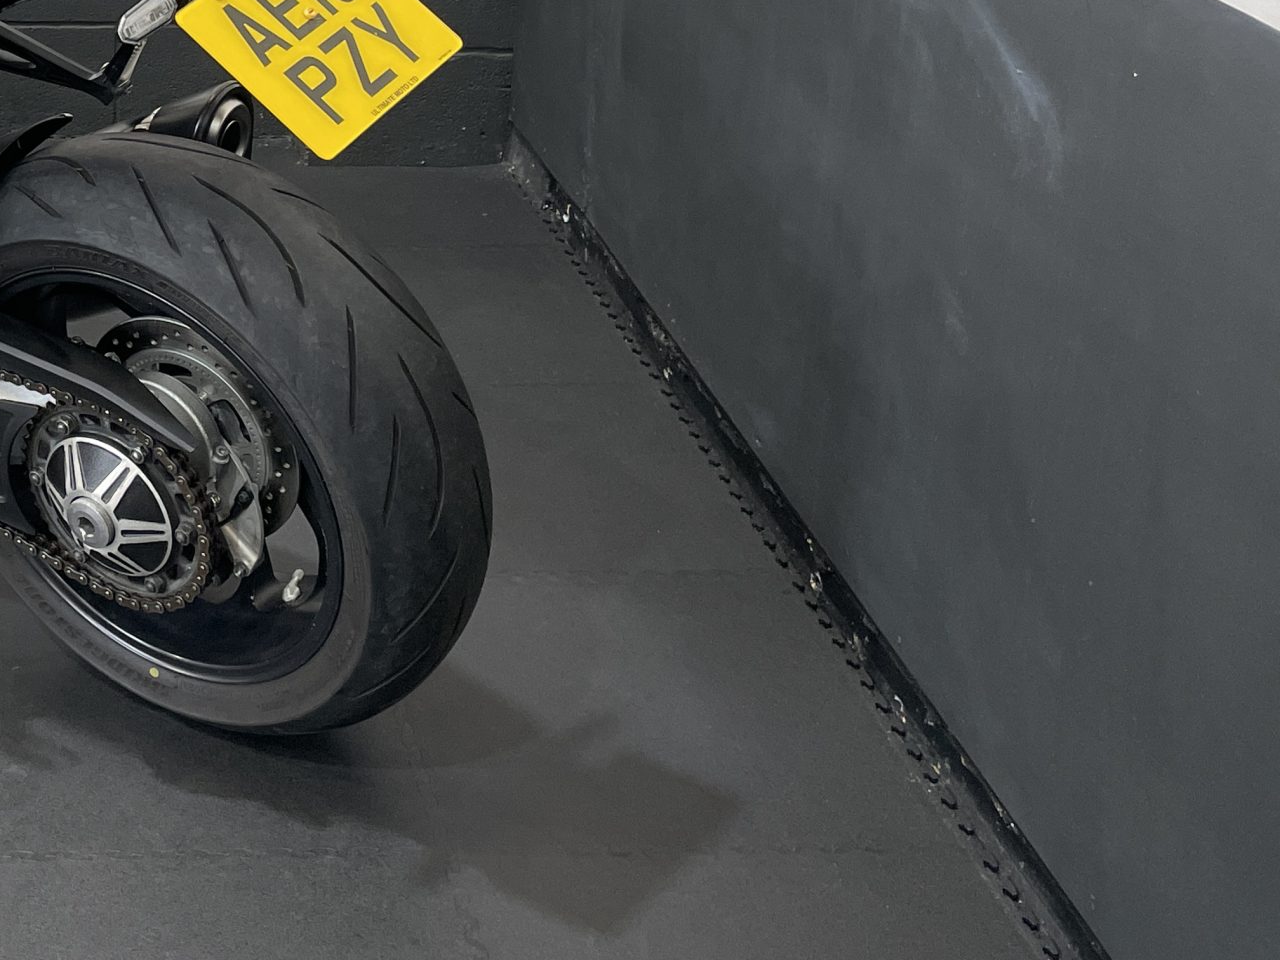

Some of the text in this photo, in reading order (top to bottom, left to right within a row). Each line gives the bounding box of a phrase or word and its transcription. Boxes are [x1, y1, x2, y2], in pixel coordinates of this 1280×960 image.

[283, 1, 420, 125] PZY
[370, 74, 420, 117] ULTIMATE MOTO LTD
